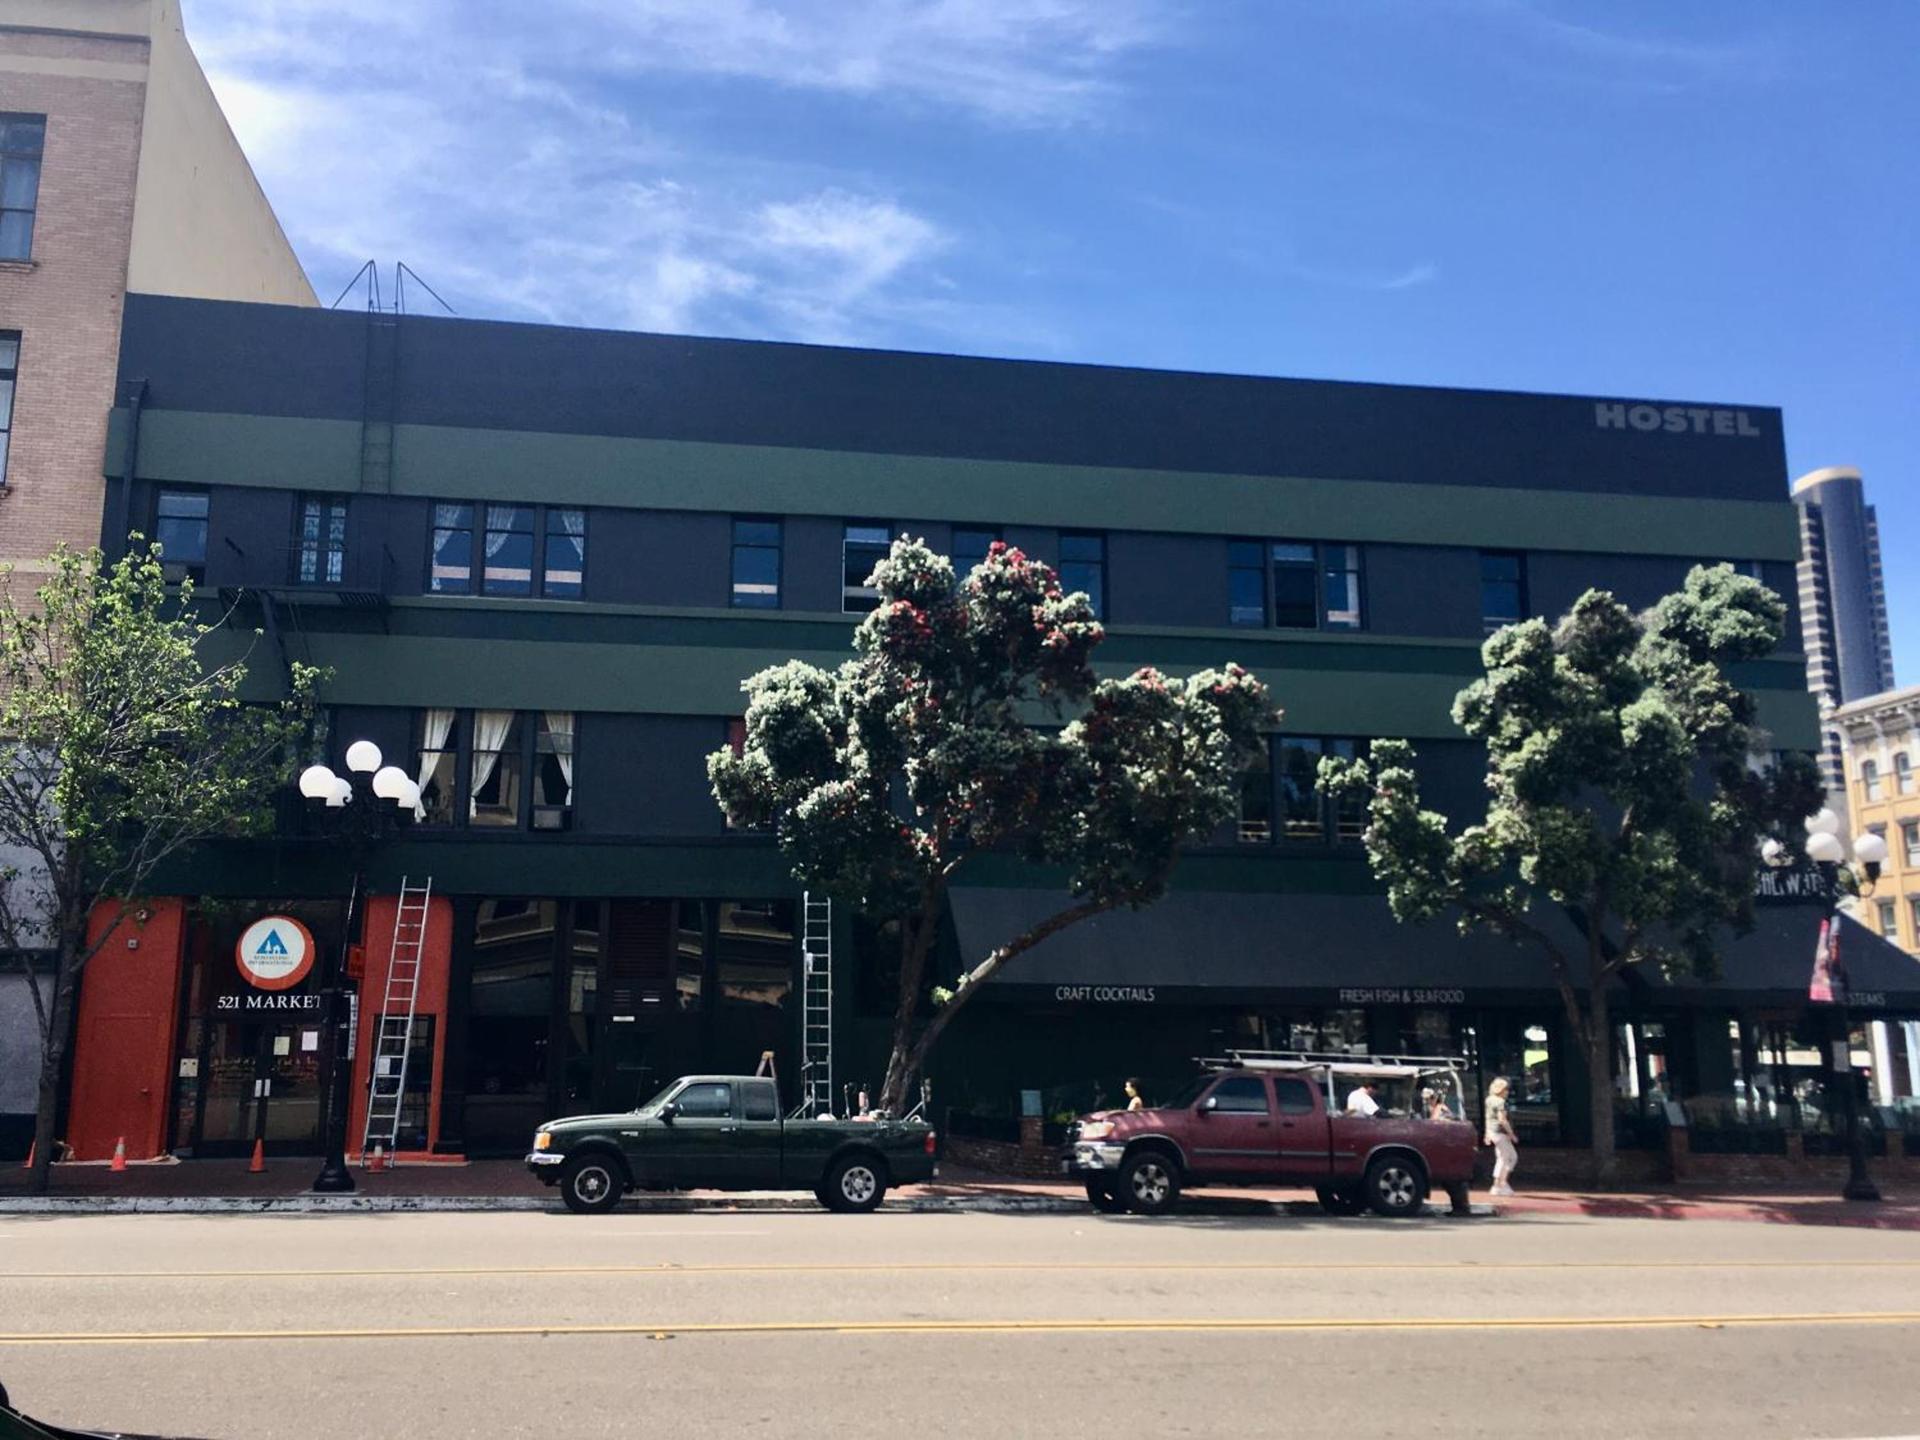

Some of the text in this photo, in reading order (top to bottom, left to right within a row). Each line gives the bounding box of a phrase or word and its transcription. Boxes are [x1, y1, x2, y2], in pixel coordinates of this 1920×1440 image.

[1594, 403, 1760, 437] HOSTEL
[1055, 986, 1155, 1001] CRAFT COCKTAILS
[1339, 988, 1374, 1003] FRESH
[1375, 988, 1400, 1003] FISH
[1413, 989, 1465, 1003] SEAFOOD
[217, 995, 320, 1009] 521 MARKET
